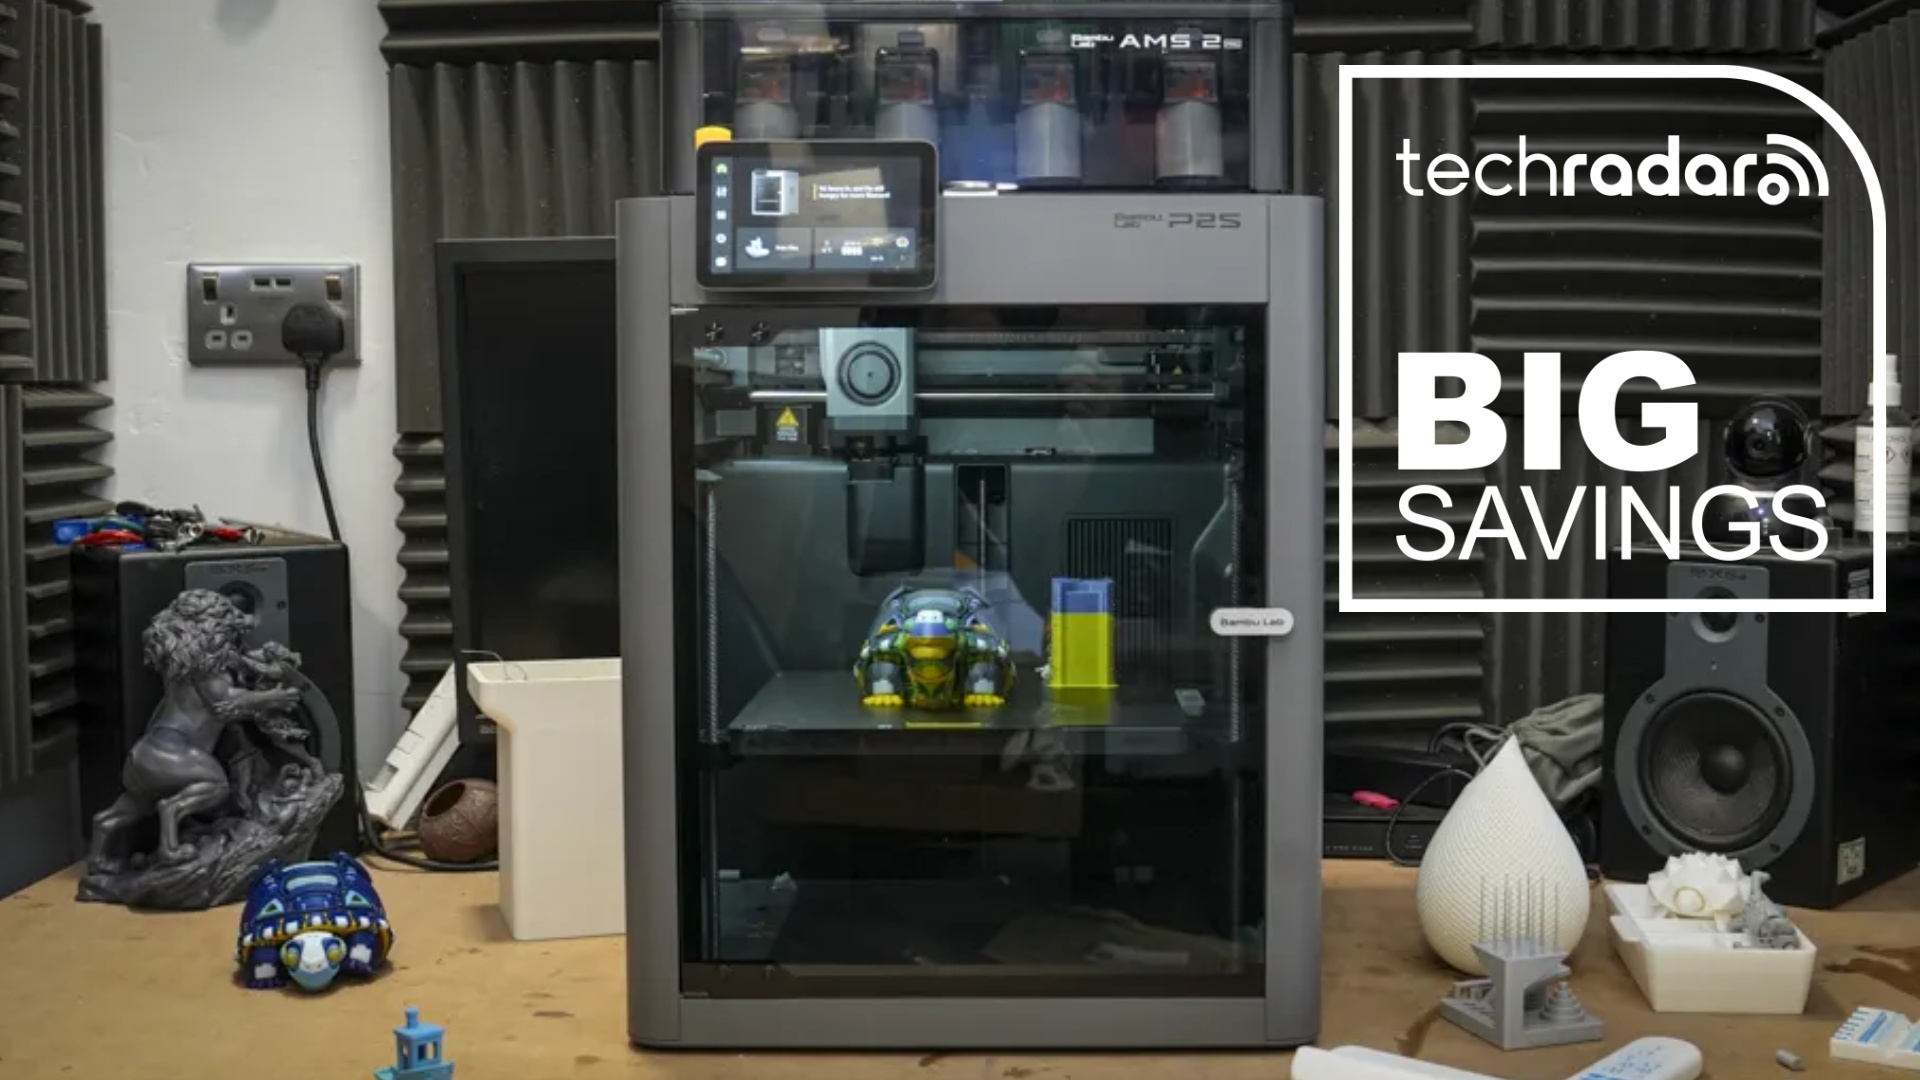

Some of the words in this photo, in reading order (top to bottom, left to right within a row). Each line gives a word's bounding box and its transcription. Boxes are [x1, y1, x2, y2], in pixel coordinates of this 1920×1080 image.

[1119, 34, 1192, 48] AMS
[1202, 34, 1222, 48] 2
[1168, 212, 1241, 228] P2S
[1220, 618, 1260, 627] Bambu
[1263, 618, 1284, 627] Lab
